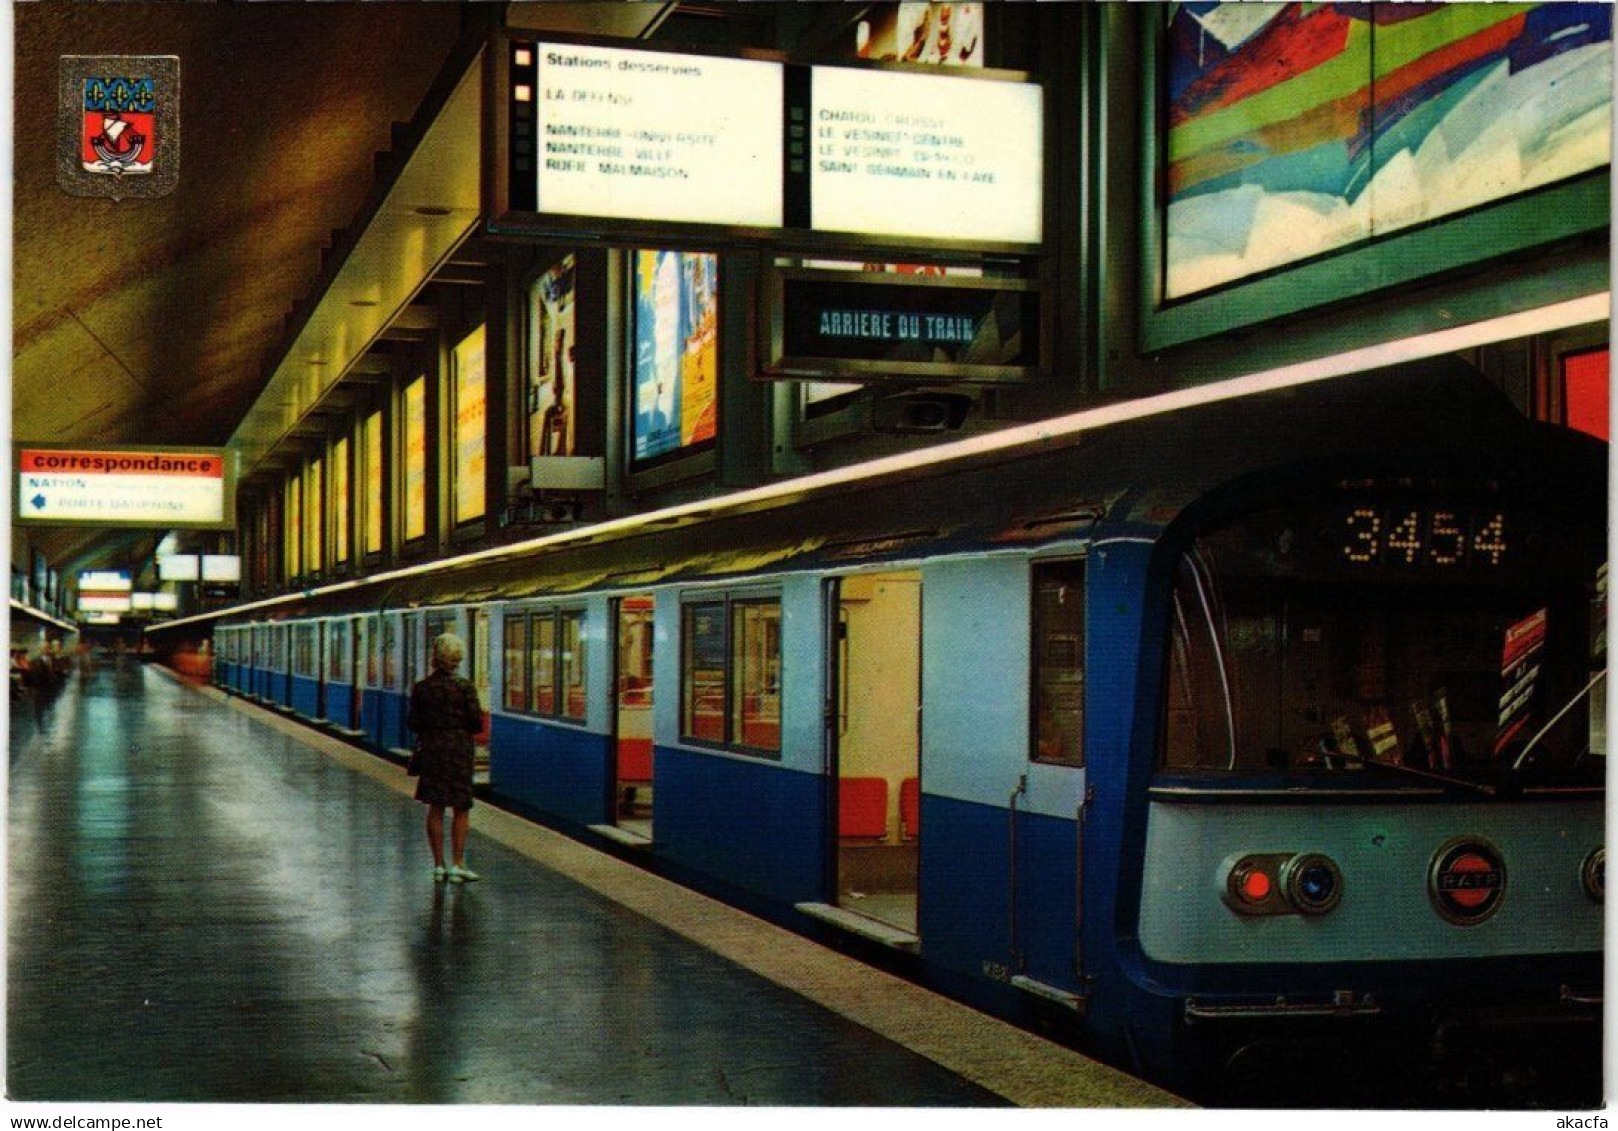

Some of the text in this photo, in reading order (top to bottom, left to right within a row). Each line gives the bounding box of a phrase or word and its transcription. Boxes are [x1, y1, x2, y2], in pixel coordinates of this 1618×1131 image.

[546, 51, 702, 76] Stations desservies
[546, 88, 565, 101] LA
[819, 126, 835, 139] LE
[546, 140, 624, 159] NANTERRE
[820, 311, 974, 341] ARRIERE DU TRAIN
[33, 455, 212, 473] correspondance
[29, 477, 86, 488] NATION
[1344, 509, 1507, 565] 3454
